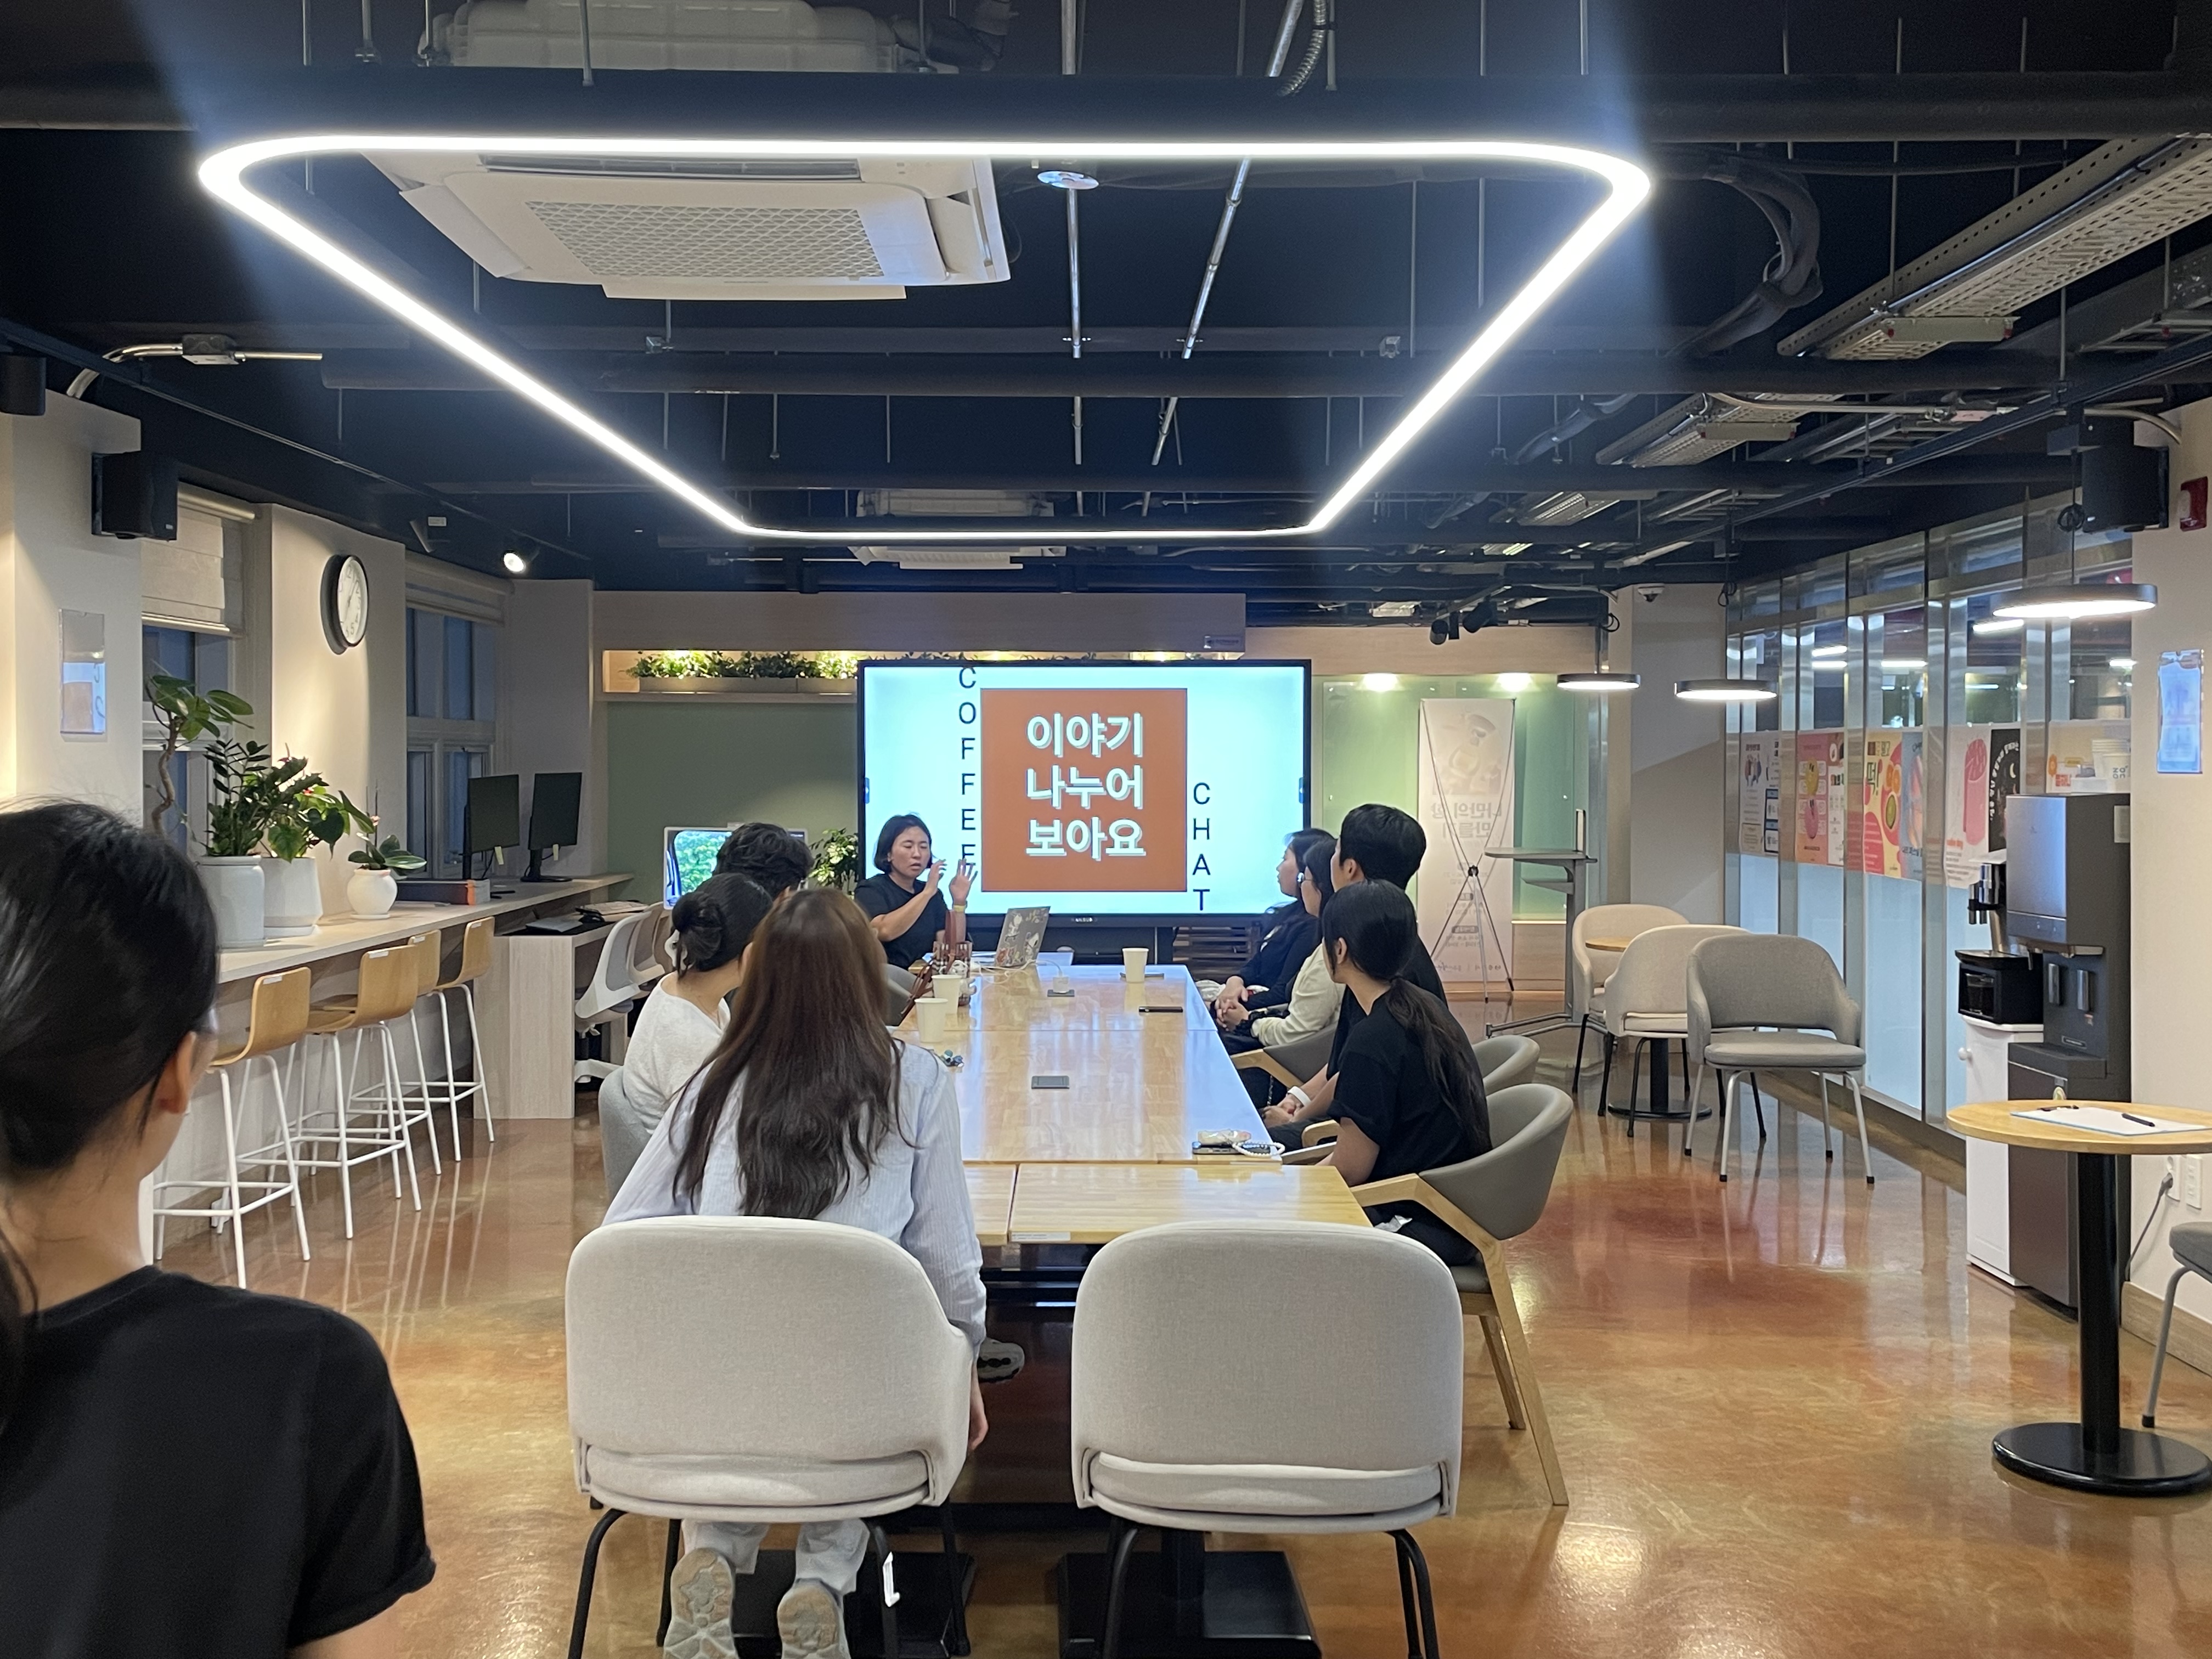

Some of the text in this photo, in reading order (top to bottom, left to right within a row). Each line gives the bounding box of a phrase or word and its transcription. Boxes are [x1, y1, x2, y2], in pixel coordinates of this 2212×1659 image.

[1026, 712, 1144, 758] 이야기
[959, 667, 976, 866] COFFEE
[1026, 764, 1144, 809] 나누어
[1026, 816, 1147, 861] 보아요
[1193, 782, 1211, 911] CHAT
